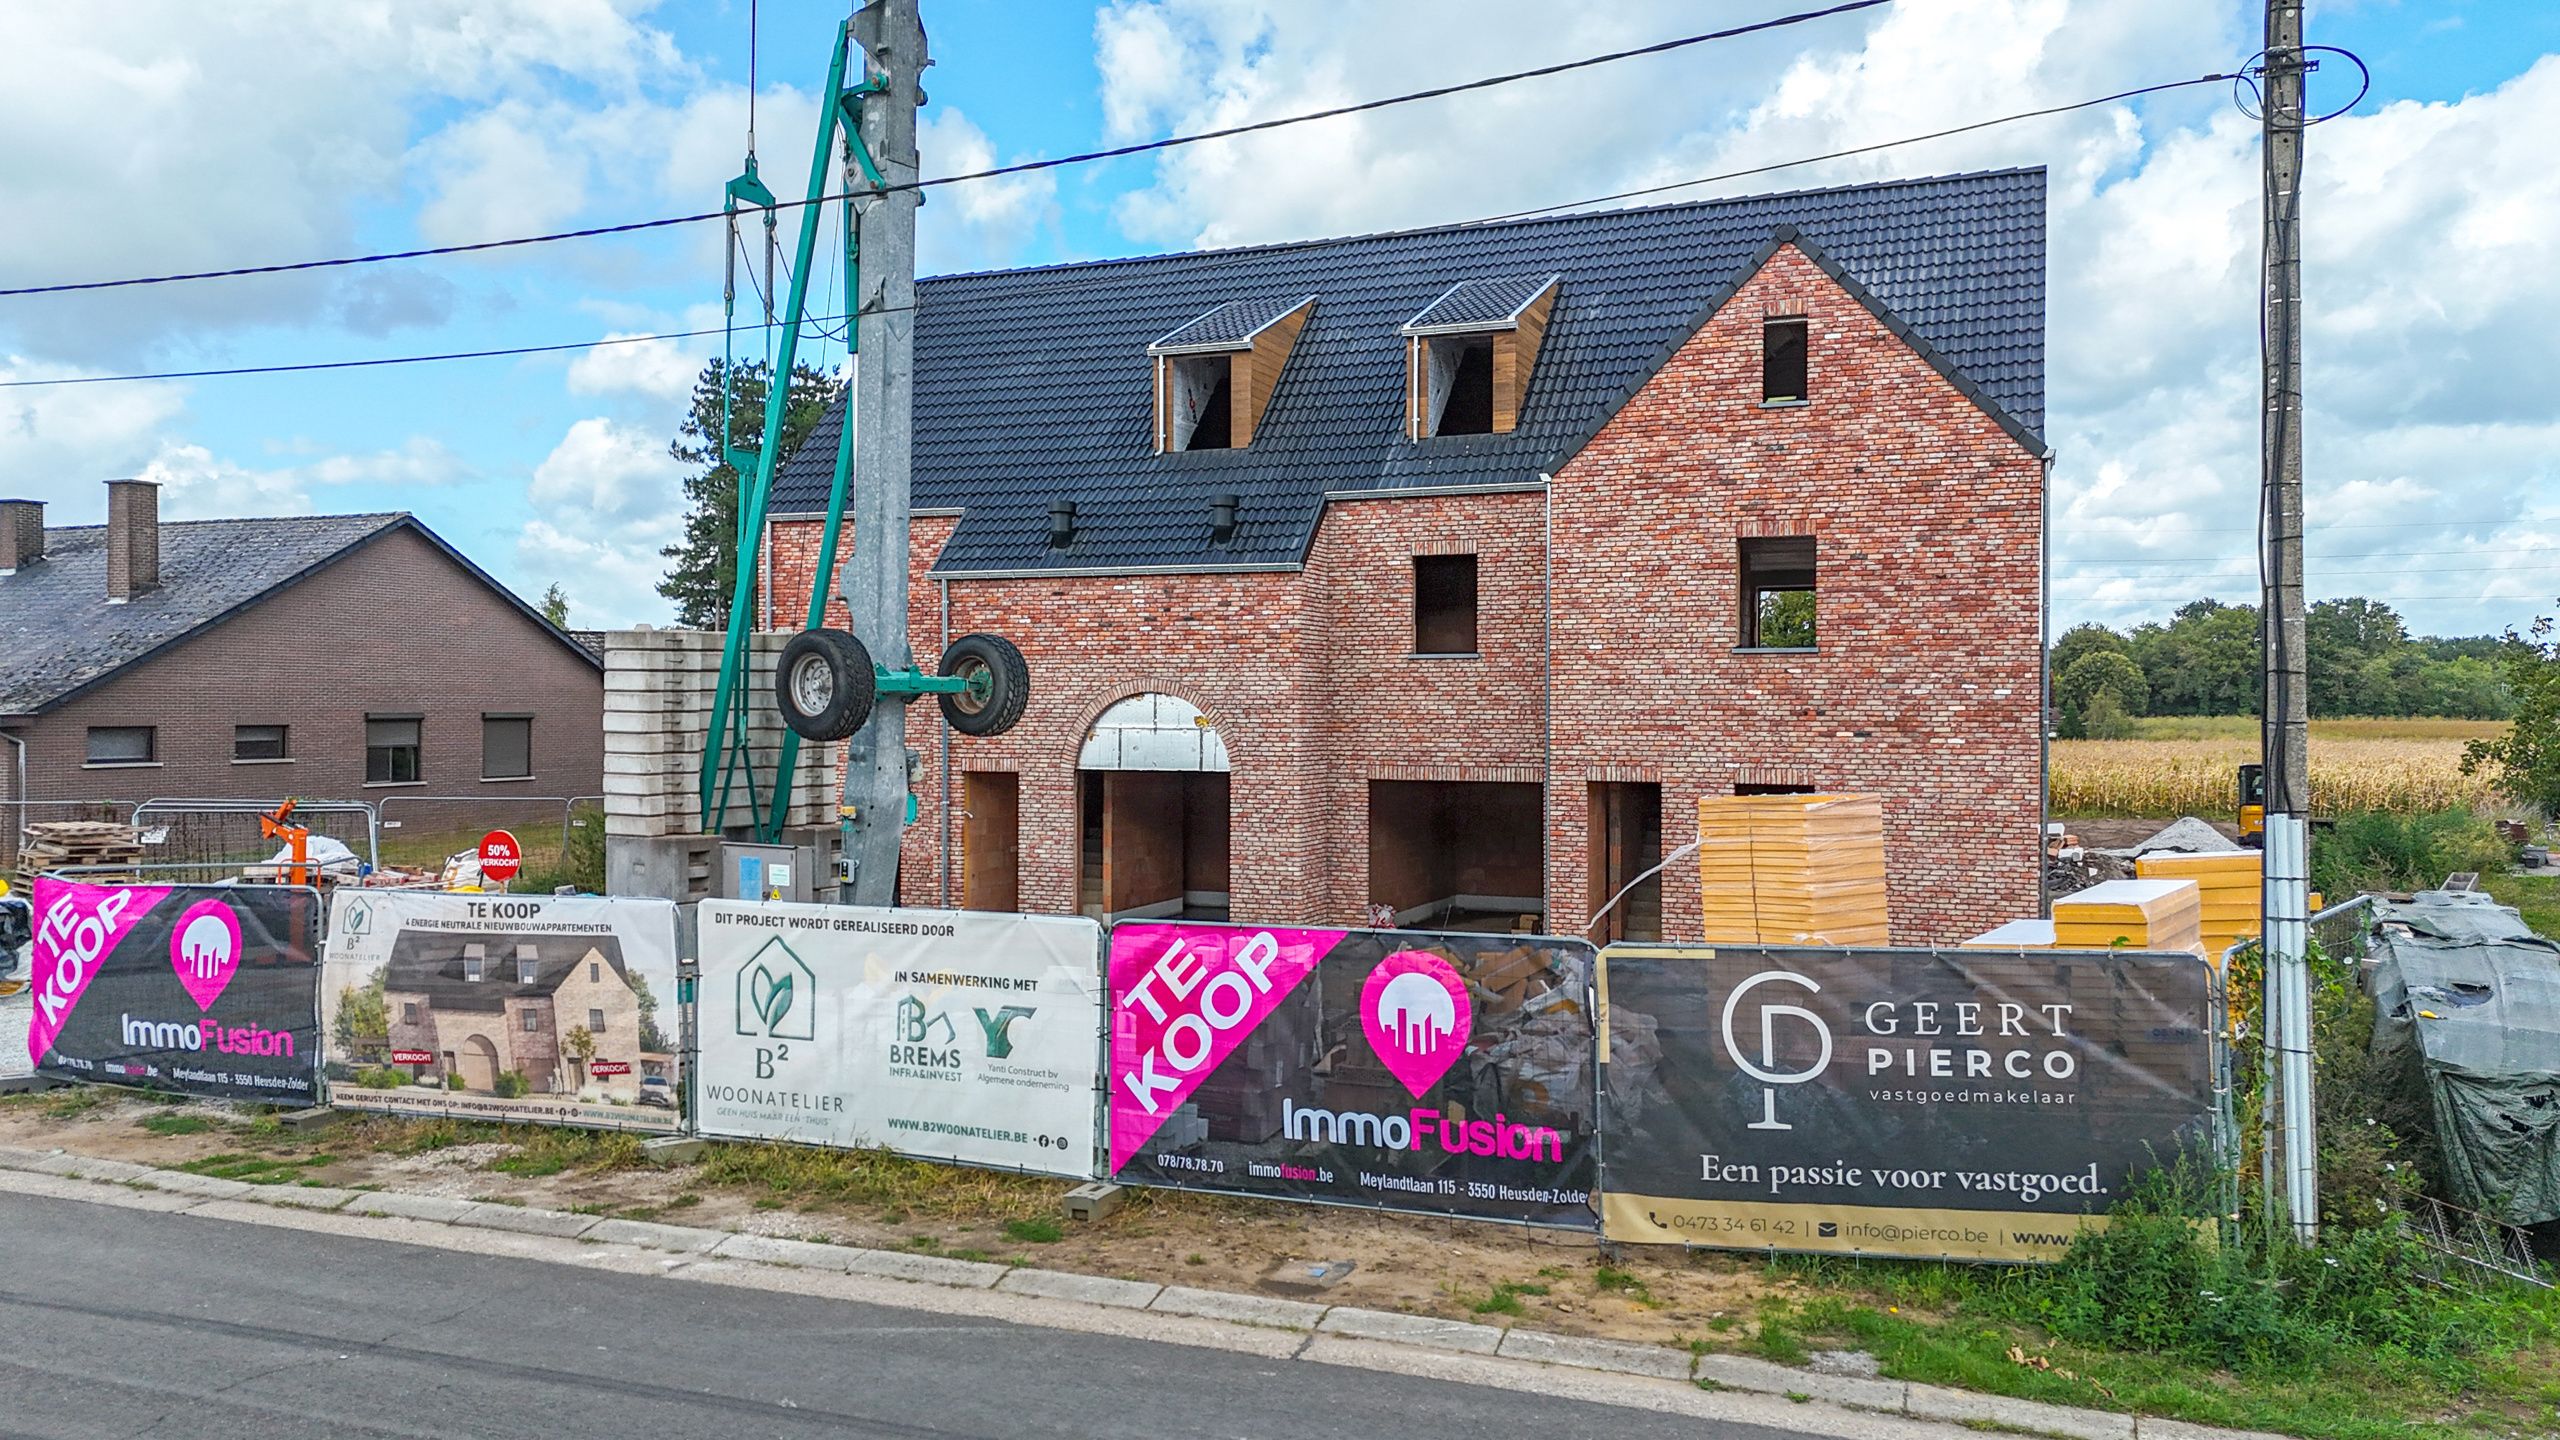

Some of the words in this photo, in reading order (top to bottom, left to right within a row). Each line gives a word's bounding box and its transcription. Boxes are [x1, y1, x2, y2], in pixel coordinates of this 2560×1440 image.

[480, 858, 519, 867] VERKOCHT
[488, 844, 510, 857] 50%
[467, 902, 486, 918] TE
[493, 902, 541, 919] KOOP
[37, 892, 80, 958] TE
[405, 919, 410, 927] 4
[411, 919, 439, 929] ENERGIE
[441, 920, 482, 931] NEUTRALE
[484, 922, 612, 933] NIEUWBOUWAPPARTEMENTEN
[715, 912, 733, 924] DIT
[736, 914, 786, 928] PROJECT
[788, 917, 830, 930] WORDT
[833, 919, 918, 936] GEREALISEERD
[922, 924, 955, 937] DOOR
[38, 888, 132, 1027] KOOP
[895, 971, 907, 982] IN
[911, 971, 1010, 990] SAMENWERKING
[1013, 979, 1038, 992] MET
[1122, 937, 1208, 1025] TE
[1123, 931, 1279, 1116] KOOP
[1865, 1001, 2072, 1037] GEERT
[121, 1013, 294, 1057] ImmoFusion
[393, 1053, 431, 1062] VERKOCHT
[890, 1044, 961, 1069] BREMS
[1868, 1048, 2075, 1080] PIERCO
[217, 1072, 228, 1084] 115
[235, 1074, 252, 1086] 3550
[254, 1075, 309, 1091] Heusden-Zolder
[889, 1067, 963, 1083] INFRA&INVEST
[977, 1074, 1015, 1087] Algemene
[1016, 1079, 1070, 1093] onderneming
[987, 1063, 1006, 1074] Yanti
[1008, 1065, 1046, 1078] Construct
[1048, 1070, 1059, 1079] bv
[336, 1093, 355, 1101] NEEM
[355, 1094, 382, 1104] GERUST
[384, 1096, 415, 1105] CONTACT
[416, 1099, 431, 1107] MET
[432, 1100, 447, 1108] ONS
[461, 1102, 554, 1115] INFO@B2WOONATELIER.BE
[706, 1084, 844, 1112] WOONATELIER
[1869, 1088, 2075, 1105] vastgoedmakelaar
[717, 1107, 738, 1117] GEEN
[739, 1110, 758, 1119] HUIS
[760, 1112, 783, 1121] MAAR
[888, 1117, 1028, 1143] WWW.B2WOONATELIER.BE
[1282, 1098, 1563, 1163] ImmoFusion
[1157, 1154, 1224, 1173] 078/78.78.70
[1249, 1160, 1334, 1183] immofusion.be
[1360, 1171, 1434, 1194] Meylandtlaan
[1437, 1179, 1456, 1195] 115
[1468, 1182, 1496, 1199] 3550
[1700, 1154, 1759, 1183] Een
[1769, 1159, 1863, 1194] passie
[1870, 1168, 1947, 1191] voor
[1955, 1162, 2108, 1203] vastgoed.
[1673, 1215, 1718, 1232] 0473
[1723, 1216, 1746, 1233] 34
[1750, 1217, 1768, 1233] 61
[1773, 1219, 1796, 1235] 42
[1846, 1222, 1989, 1244] info@pierco.be
